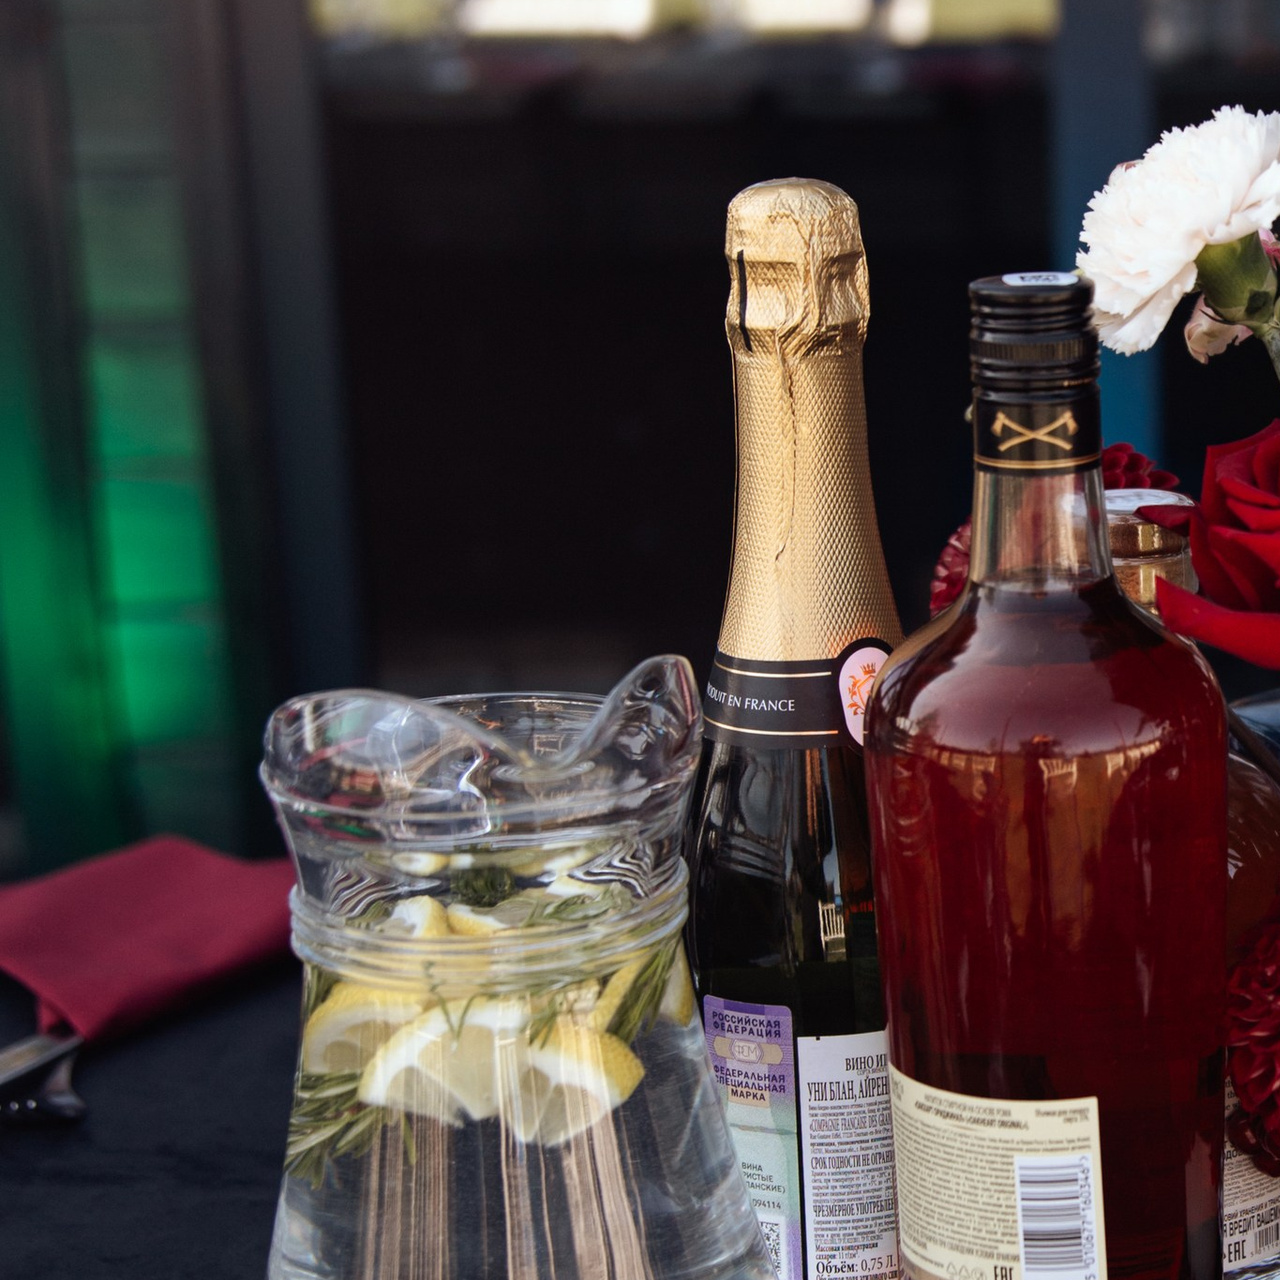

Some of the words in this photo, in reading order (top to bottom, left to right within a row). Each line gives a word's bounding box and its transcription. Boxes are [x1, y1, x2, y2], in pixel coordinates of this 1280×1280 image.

[728, 694, 742, 708] EN
[744, 697, 795, 712] FRANCE
[712, 1010, 781, 1029] РОССИЙСКАЯ
[713, 1021, 781, 1038] ФЕДЕРАЦИЯ
[845, 1055, 874, 1072] ВИНО
[713, 1064, 786, 1083] ФЕДЕРАЛЬНАЯ
[730, 1088, 766, 1101] МАРКА
[807, 1081, 828, 1102] УНИ
[829, 1080, 857, 1103] БЛАН,
[741, 1161, 763, 1172] ВИНА
[811, 1156, 828, 1170] СРОК
[828, 1154, 861, 1170] ГОДНОСТИ
[862, 1153, 871, 1167] НЕ
[1079, 1168, 1092, 1212] 160346
[813, 1203, 855, 1218] ЧРЕЗМЕРНОЕ
[815, 1244, 840, 1253] Массовая
[1081, 1220, 1095, 1267] 010677
[1228, 1239, 1247, 1263] EAC
[816, 1261, 858, 1274] Объём:
[861, 1257, 883, 1272] 0,75
[885, 1255, 896, 1268] Л.
